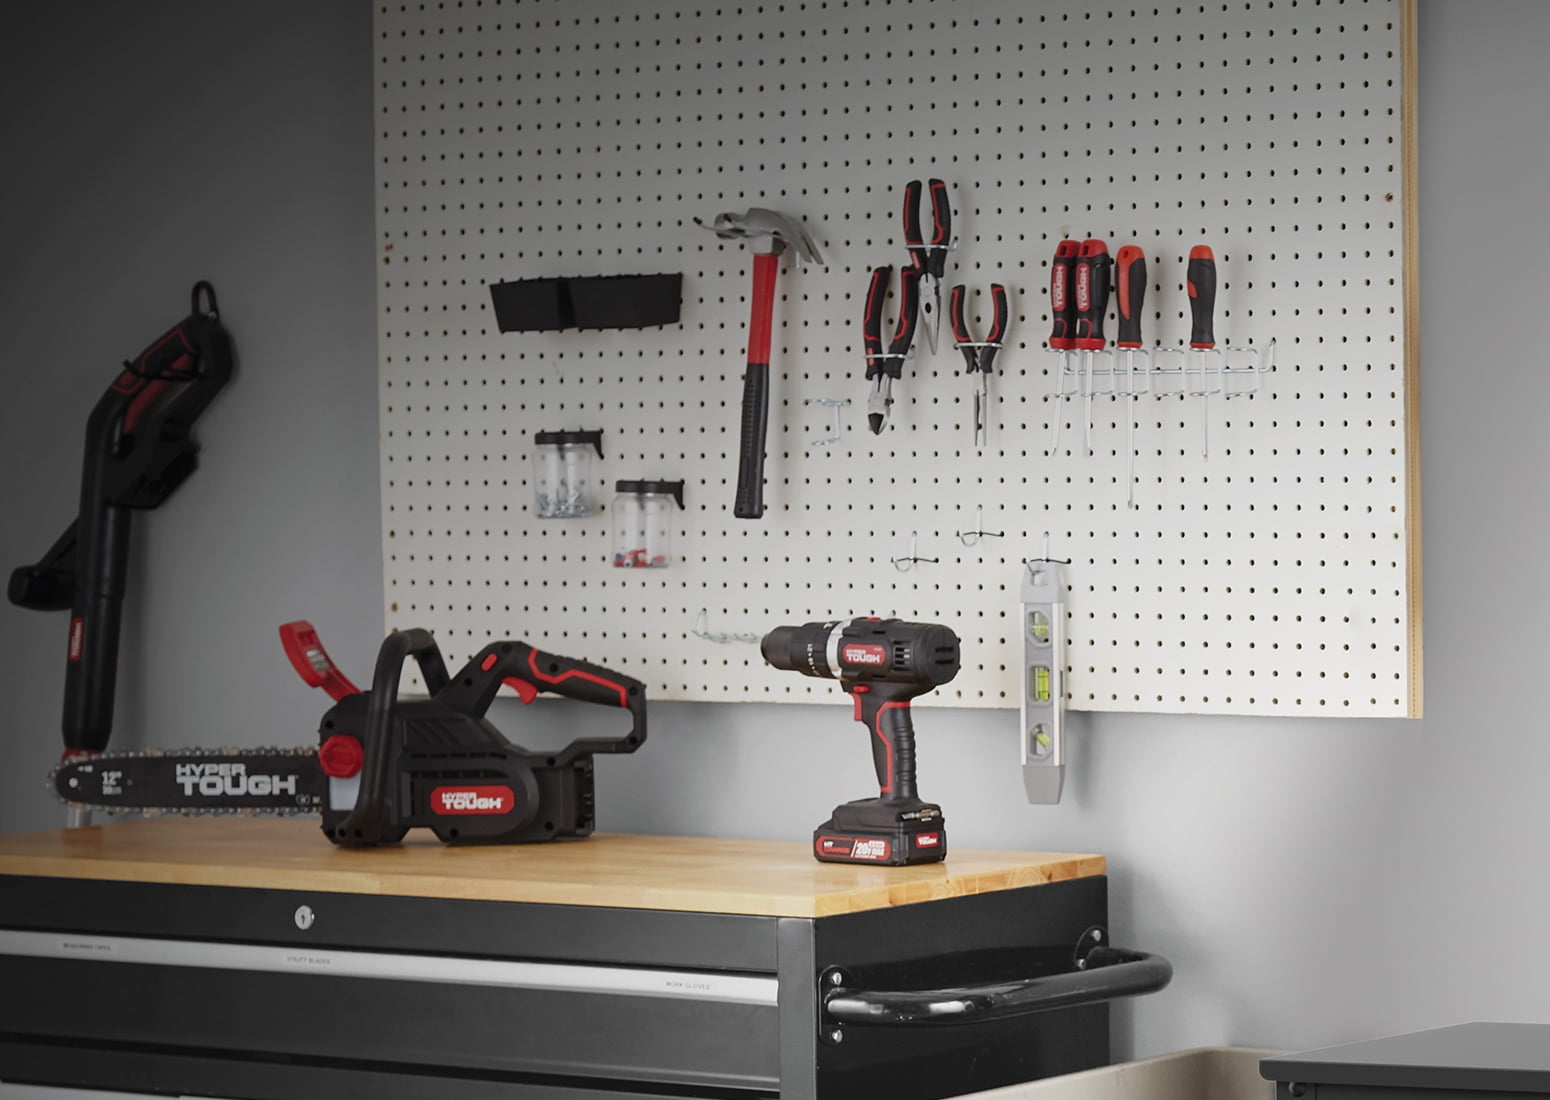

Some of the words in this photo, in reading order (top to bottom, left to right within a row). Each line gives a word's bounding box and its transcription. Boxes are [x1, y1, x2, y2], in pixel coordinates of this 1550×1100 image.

[846, 653, 881, 663] TOUGH
[176, 763, 247, 776] HYPER
[176, 774, 296, 797] TOUGH
[441, 797, 503, 810] TOUGH
